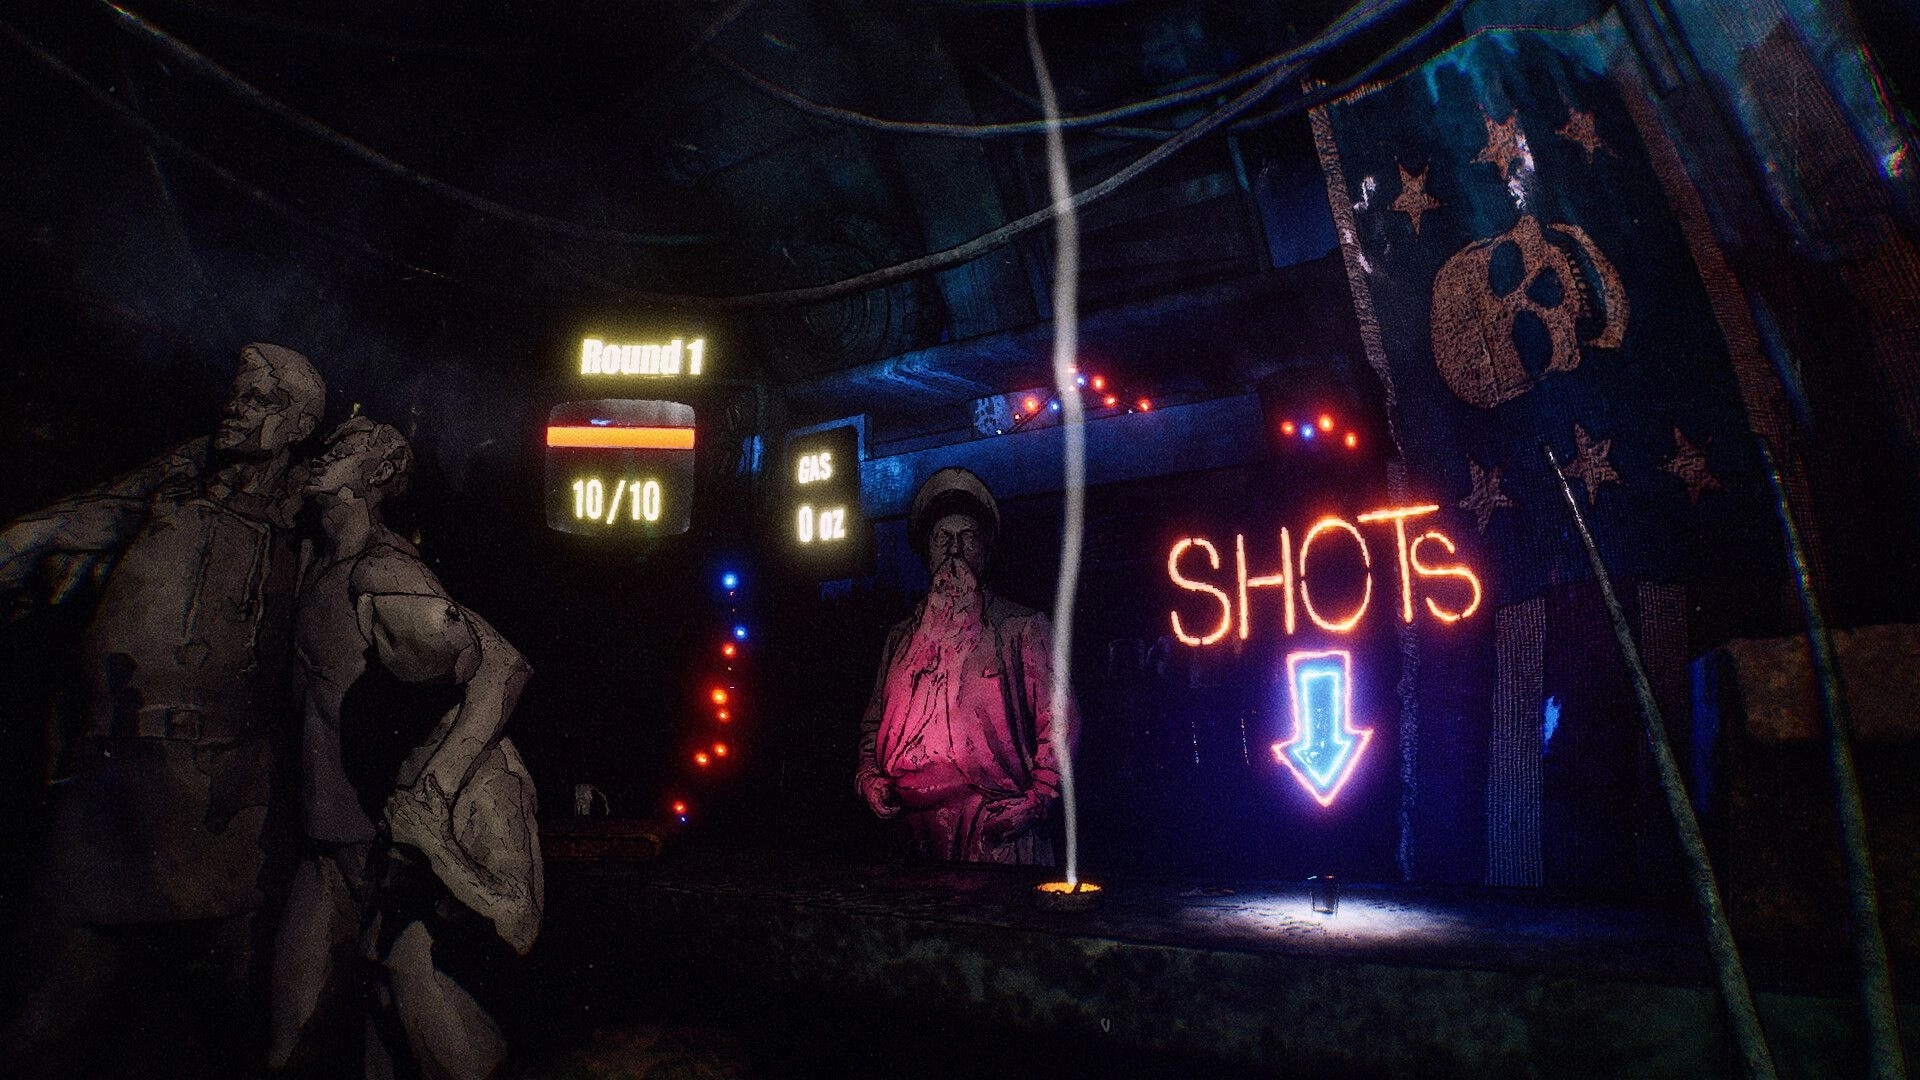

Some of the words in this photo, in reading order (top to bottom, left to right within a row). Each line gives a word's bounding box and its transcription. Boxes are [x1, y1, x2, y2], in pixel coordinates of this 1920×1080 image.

[580, 338, 682, 376] Round
[686, 338, 704, 375] 1
[798, 452, 833, 484] GAS
[798, 505, 813, 543] 0
[820, 507, 846, 541] oz
